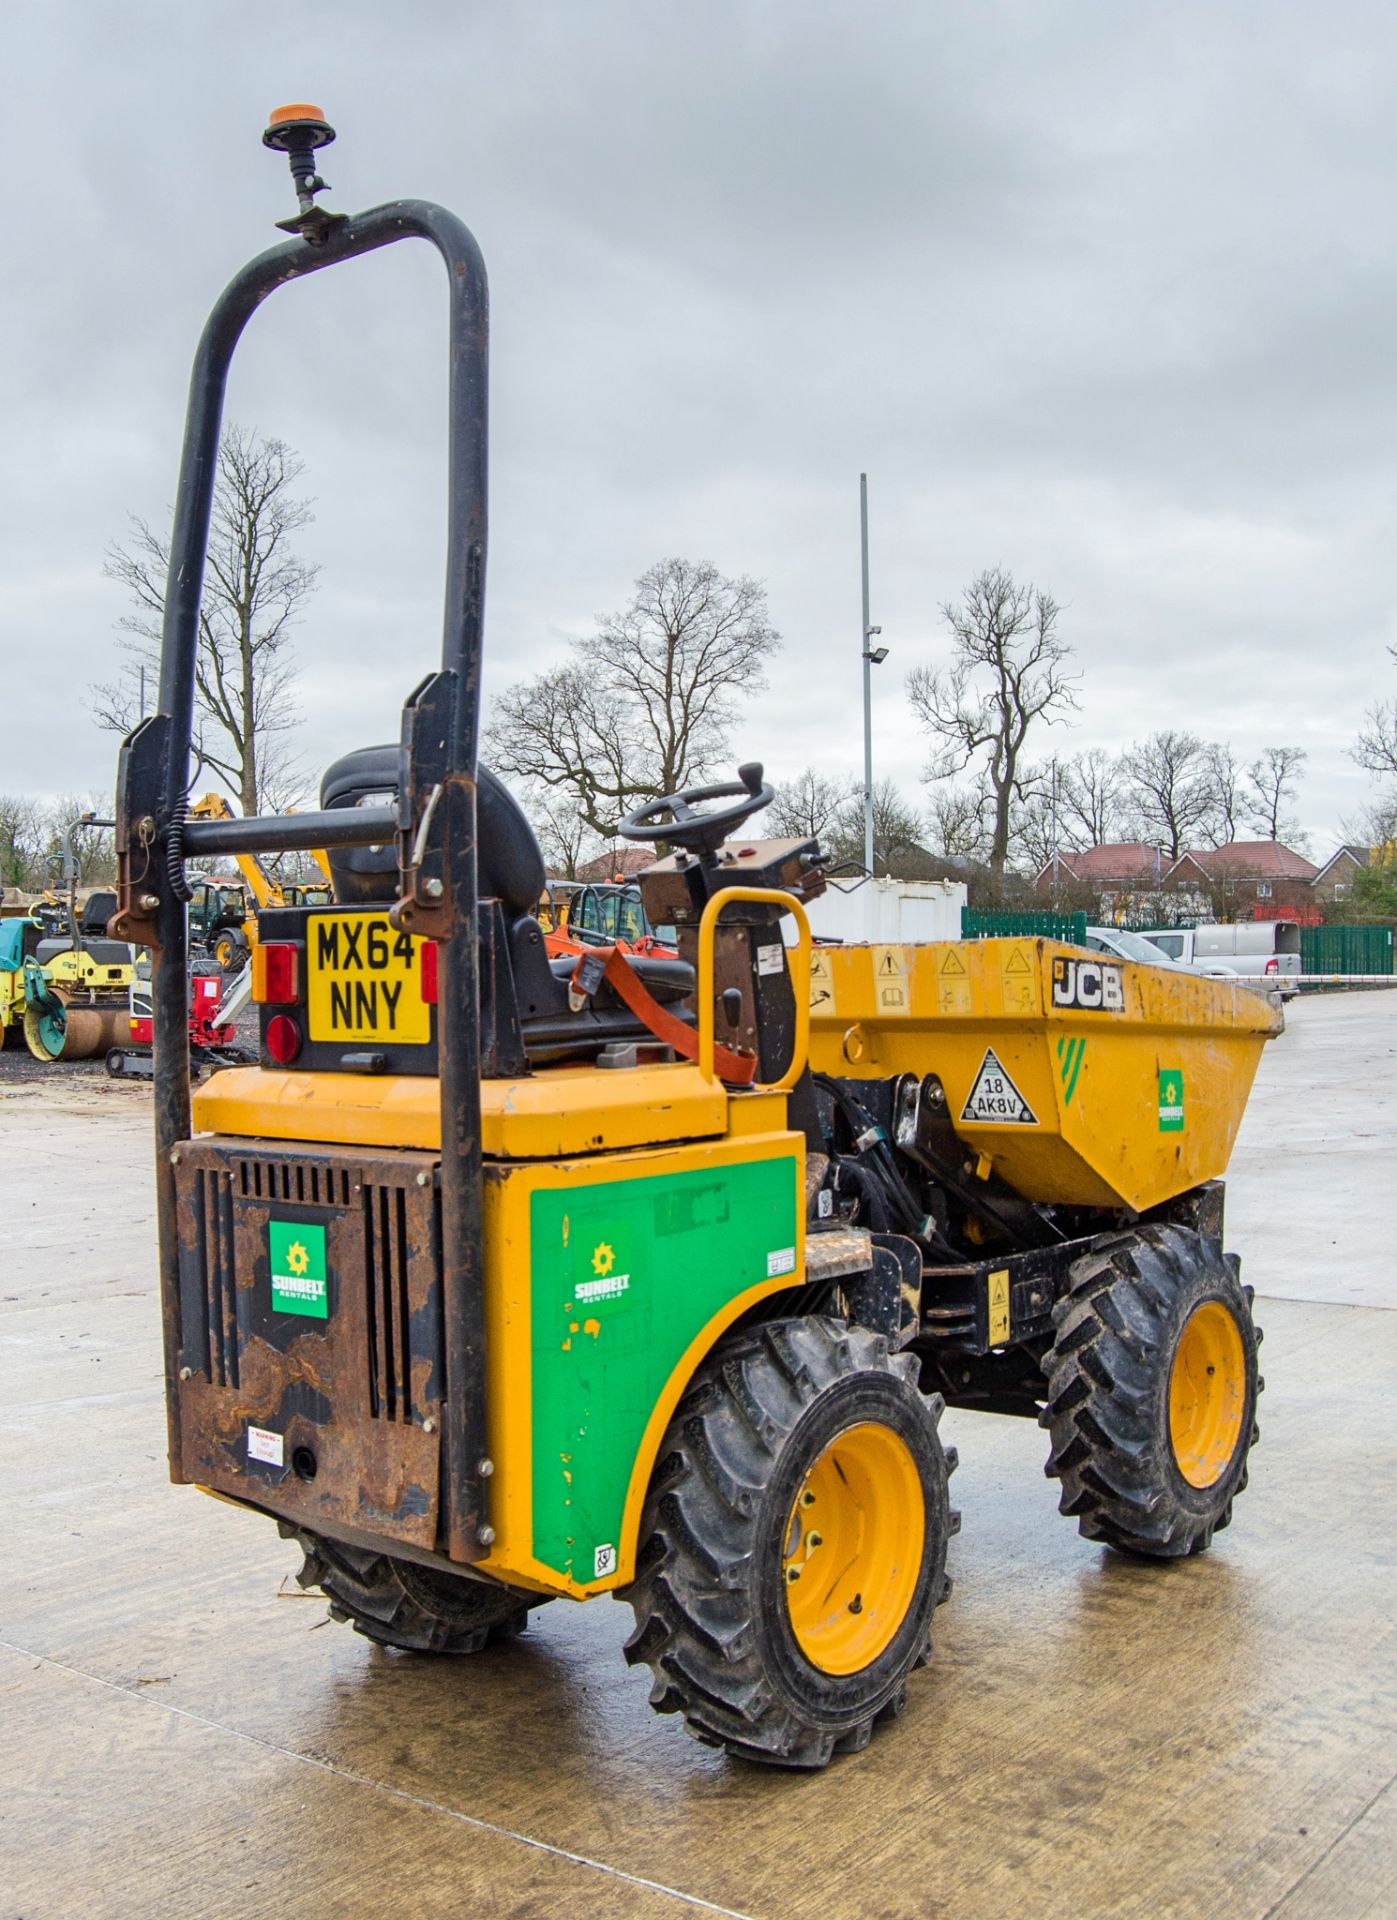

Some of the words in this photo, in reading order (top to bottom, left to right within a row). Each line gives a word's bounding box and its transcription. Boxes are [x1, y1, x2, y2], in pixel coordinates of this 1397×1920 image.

[318, 921, 415, 970] MX64
[1054, 961, 1123, 1008] JCB
[331, 981, 402, 1030] NNY
[984, 1078, 1004, 1094] 18
[977, 1097, 1016, 1114] AK8V
[272, 1275, 325, 1295] SUNBELT
[575, 1274, 630, 1299] SUNBELT
[279, 1290, 318, 1301] RENTALS
[583, 1292, 622, 1303] RENTALS
